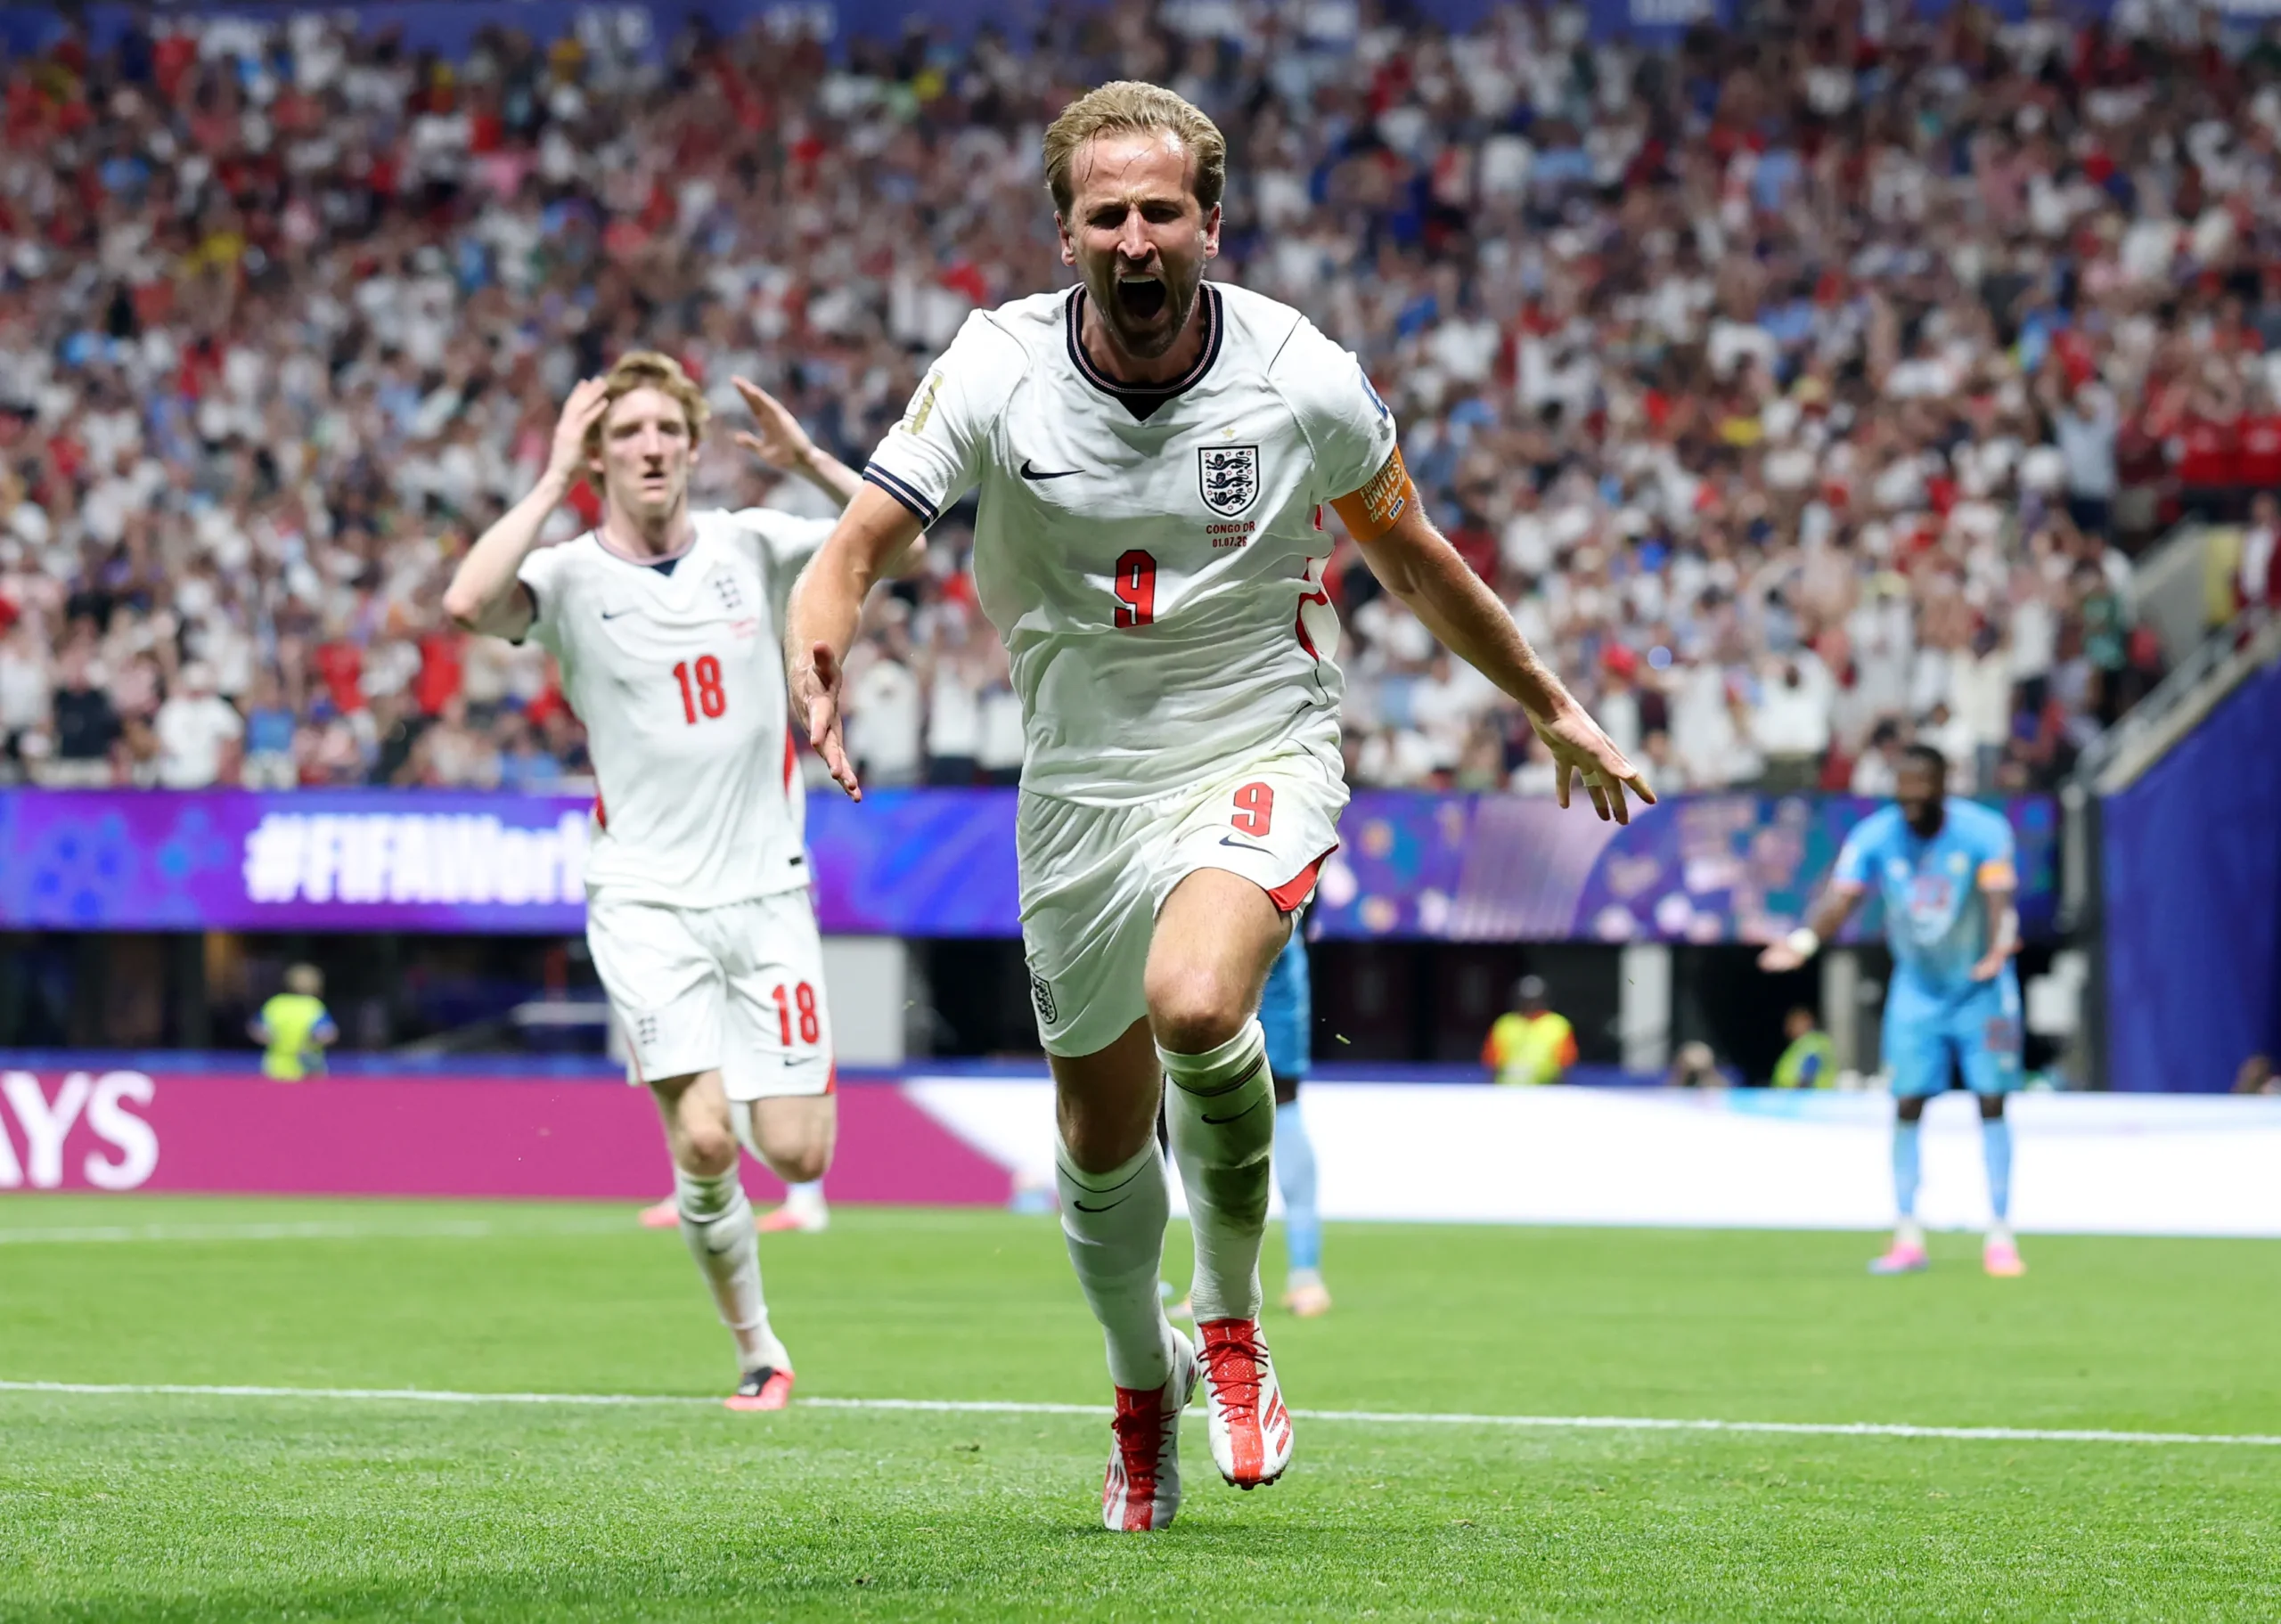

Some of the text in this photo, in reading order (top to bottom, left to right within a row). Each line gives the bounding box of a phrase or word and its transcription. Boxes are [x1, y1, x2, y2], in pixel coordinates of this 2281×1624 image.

[1364, 463, 1400, 510] UNITES
[1369, 469, 1406, 524] the World
[1390, 499, 1403, 518] FIFA
[1206, 520, 1255, 535] CONGO DR
[1212, 535, 1247, 548] 01.07.26
[1114, 549, 1157, 629] 9
[673, 654, 727, 725] 18
[1230, 781, 1274, 837] 9
[772, 981, 820, 1047] 18
